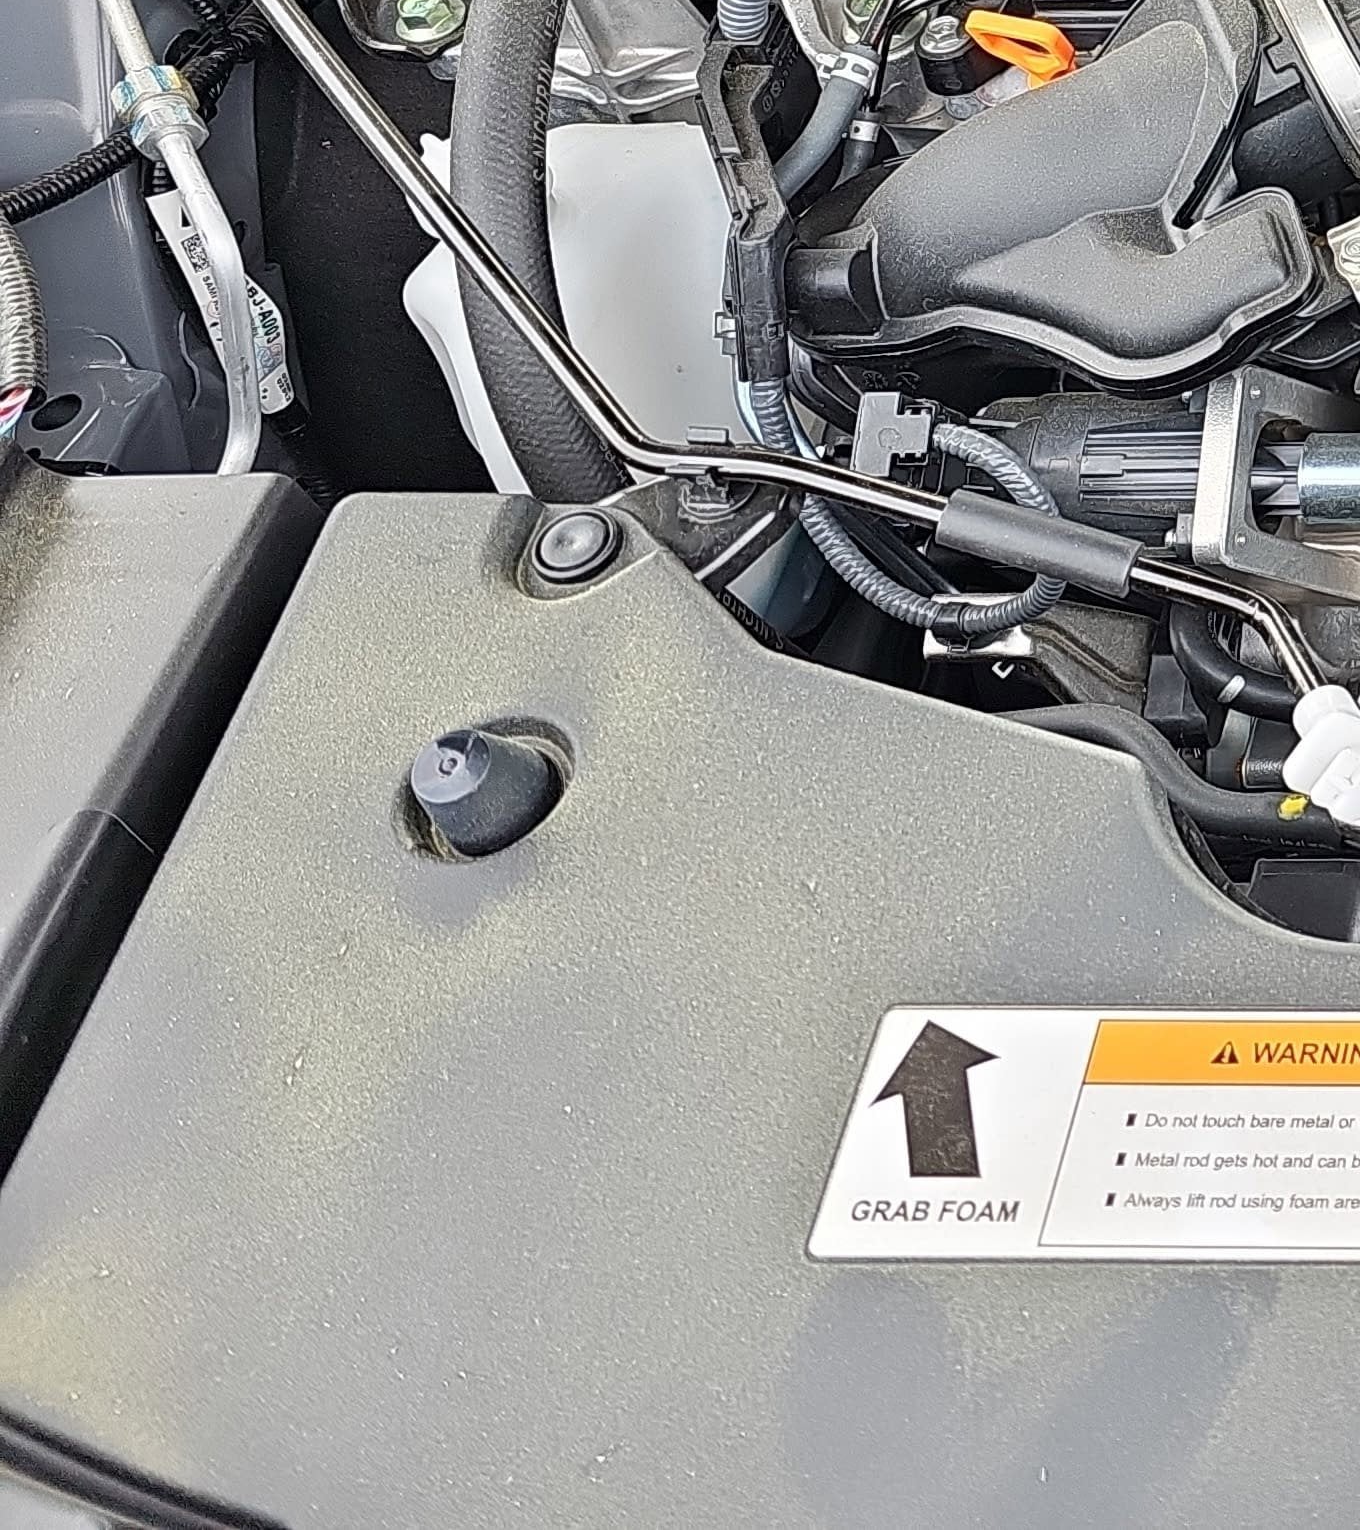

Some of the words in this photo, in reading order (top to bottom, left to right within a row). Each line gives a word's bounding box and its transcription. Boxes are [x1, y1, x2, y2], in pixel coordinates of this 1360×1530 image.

[244, 279, 281, 344] BJ-A003
[1145, 1113, 1165, 1127] Do
[1167, 1115, 1197, 1128] not
[1202, 1114, 1245, 1128] touch
[1250, 1115, 1285, 1128] bare
[1290, 1115, 1334, 1128] metal
[1339, 1118, 1355, 1129] or
[1135, 1153, 1179, 1167] Metal
[1183, 1154, 1210, 1167] rod
[1213, 1155, 1248, 1171] gets
[1253, 1154, 1278, 1168] hot
[1283, 1154, 1313, 1168] and
[1318, 1158, 1346, 1168] can
[852, 1200, 930, 1221] GRAB
[939, 1201, 1020, 1222] FOAM
[1124, 1193, 1181, 1211] Always
[1187, 1194, 1205, 1208] lift
[1210, 1194, 1237, 1208] rod
[1241, 1194, 1284, 1212] using
[1290, 1194, 1329, 1209] foam
